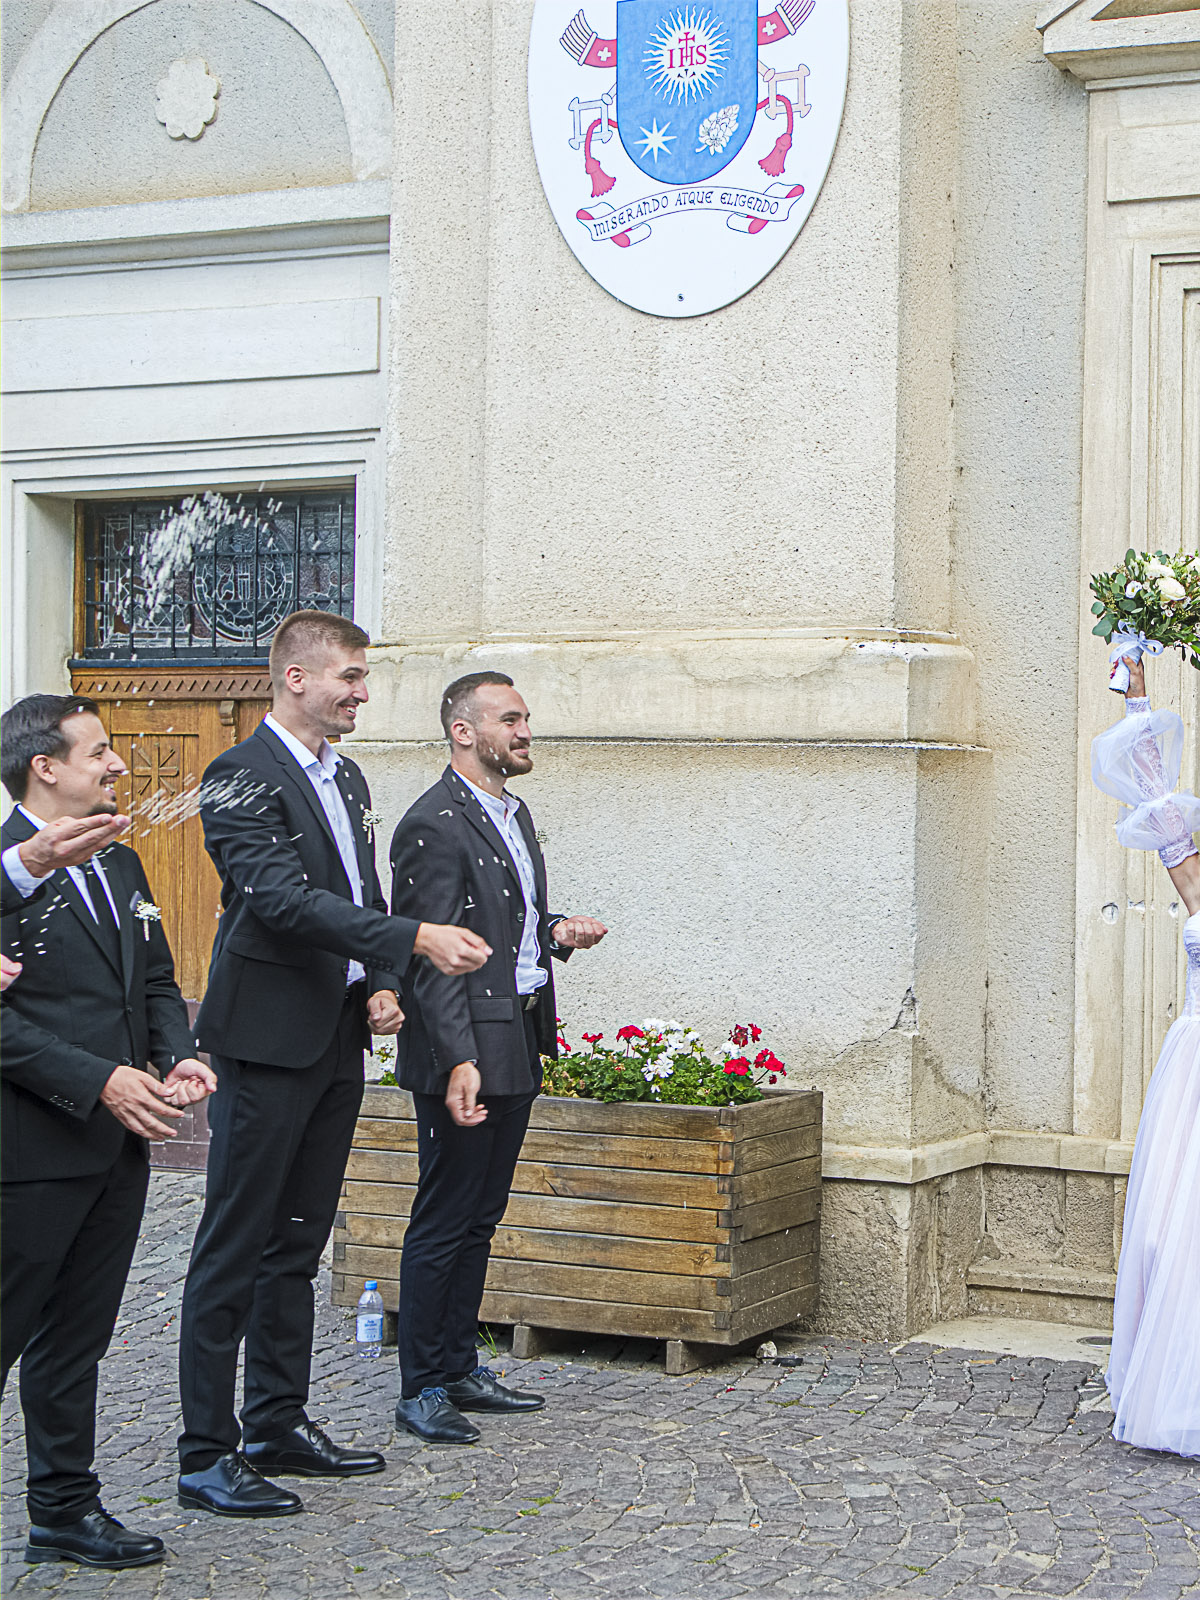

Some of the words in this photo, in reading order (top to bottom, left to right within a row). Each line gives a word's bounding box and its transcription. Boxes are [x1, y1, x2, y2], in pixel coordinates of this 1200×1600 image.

[667, 44, 707, 69] IHS
[593, 195, 668, 236] MISERANDO
[674, 191, 714, 206] ATQUE
[720, 192, 779, 214] ELIGENDO
